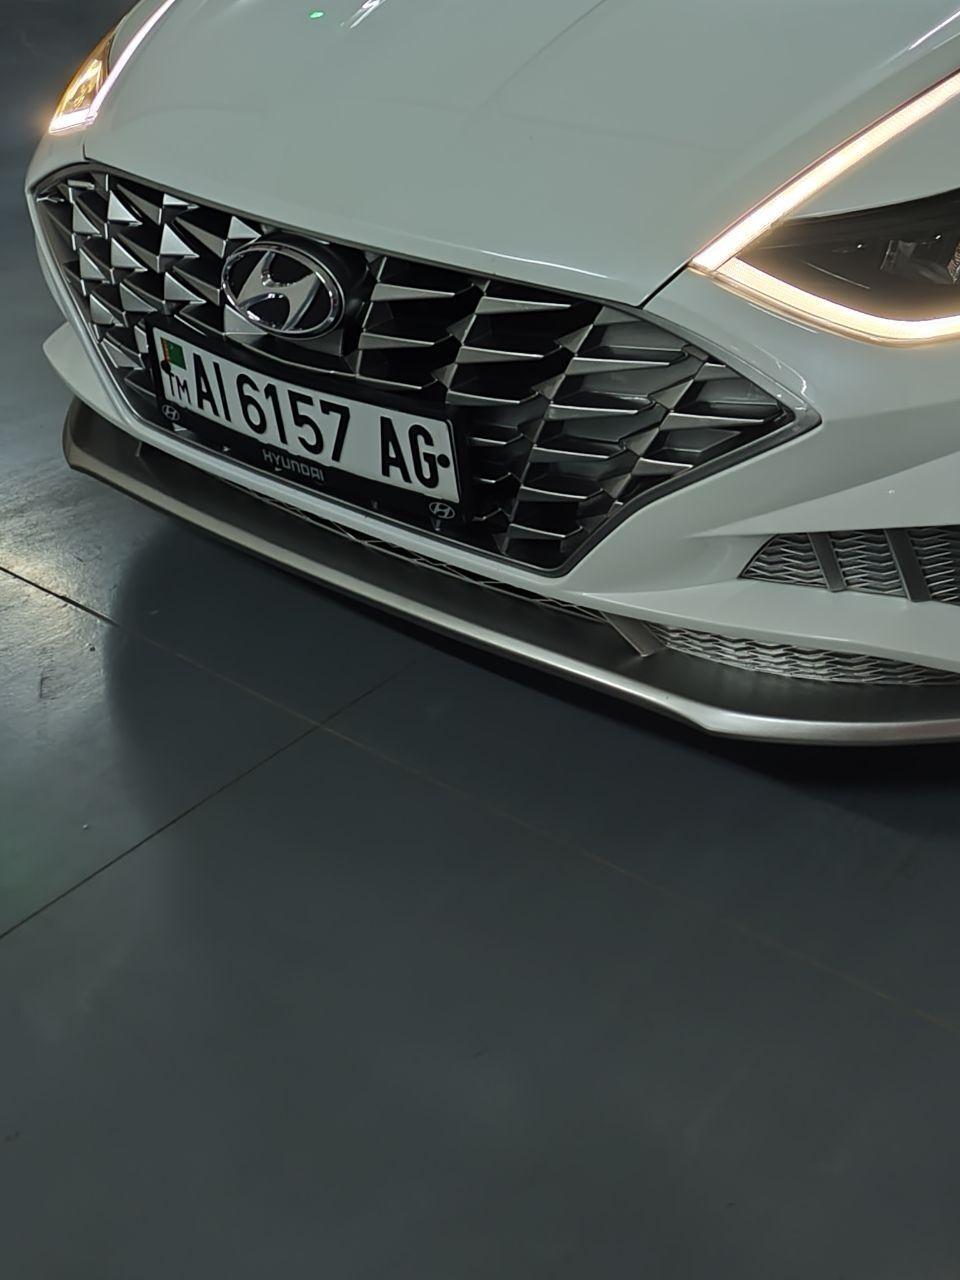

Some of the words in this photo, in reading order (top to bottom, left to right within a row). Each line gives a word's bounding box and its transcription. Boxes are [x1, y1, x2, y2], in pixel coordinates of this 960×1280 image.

[164, 370, 192, 405] TM
[236, 373, 351, 462] 6157
[380, 416, 440, 489] AG
[262, 449, 325, 481] HYUNDAI
